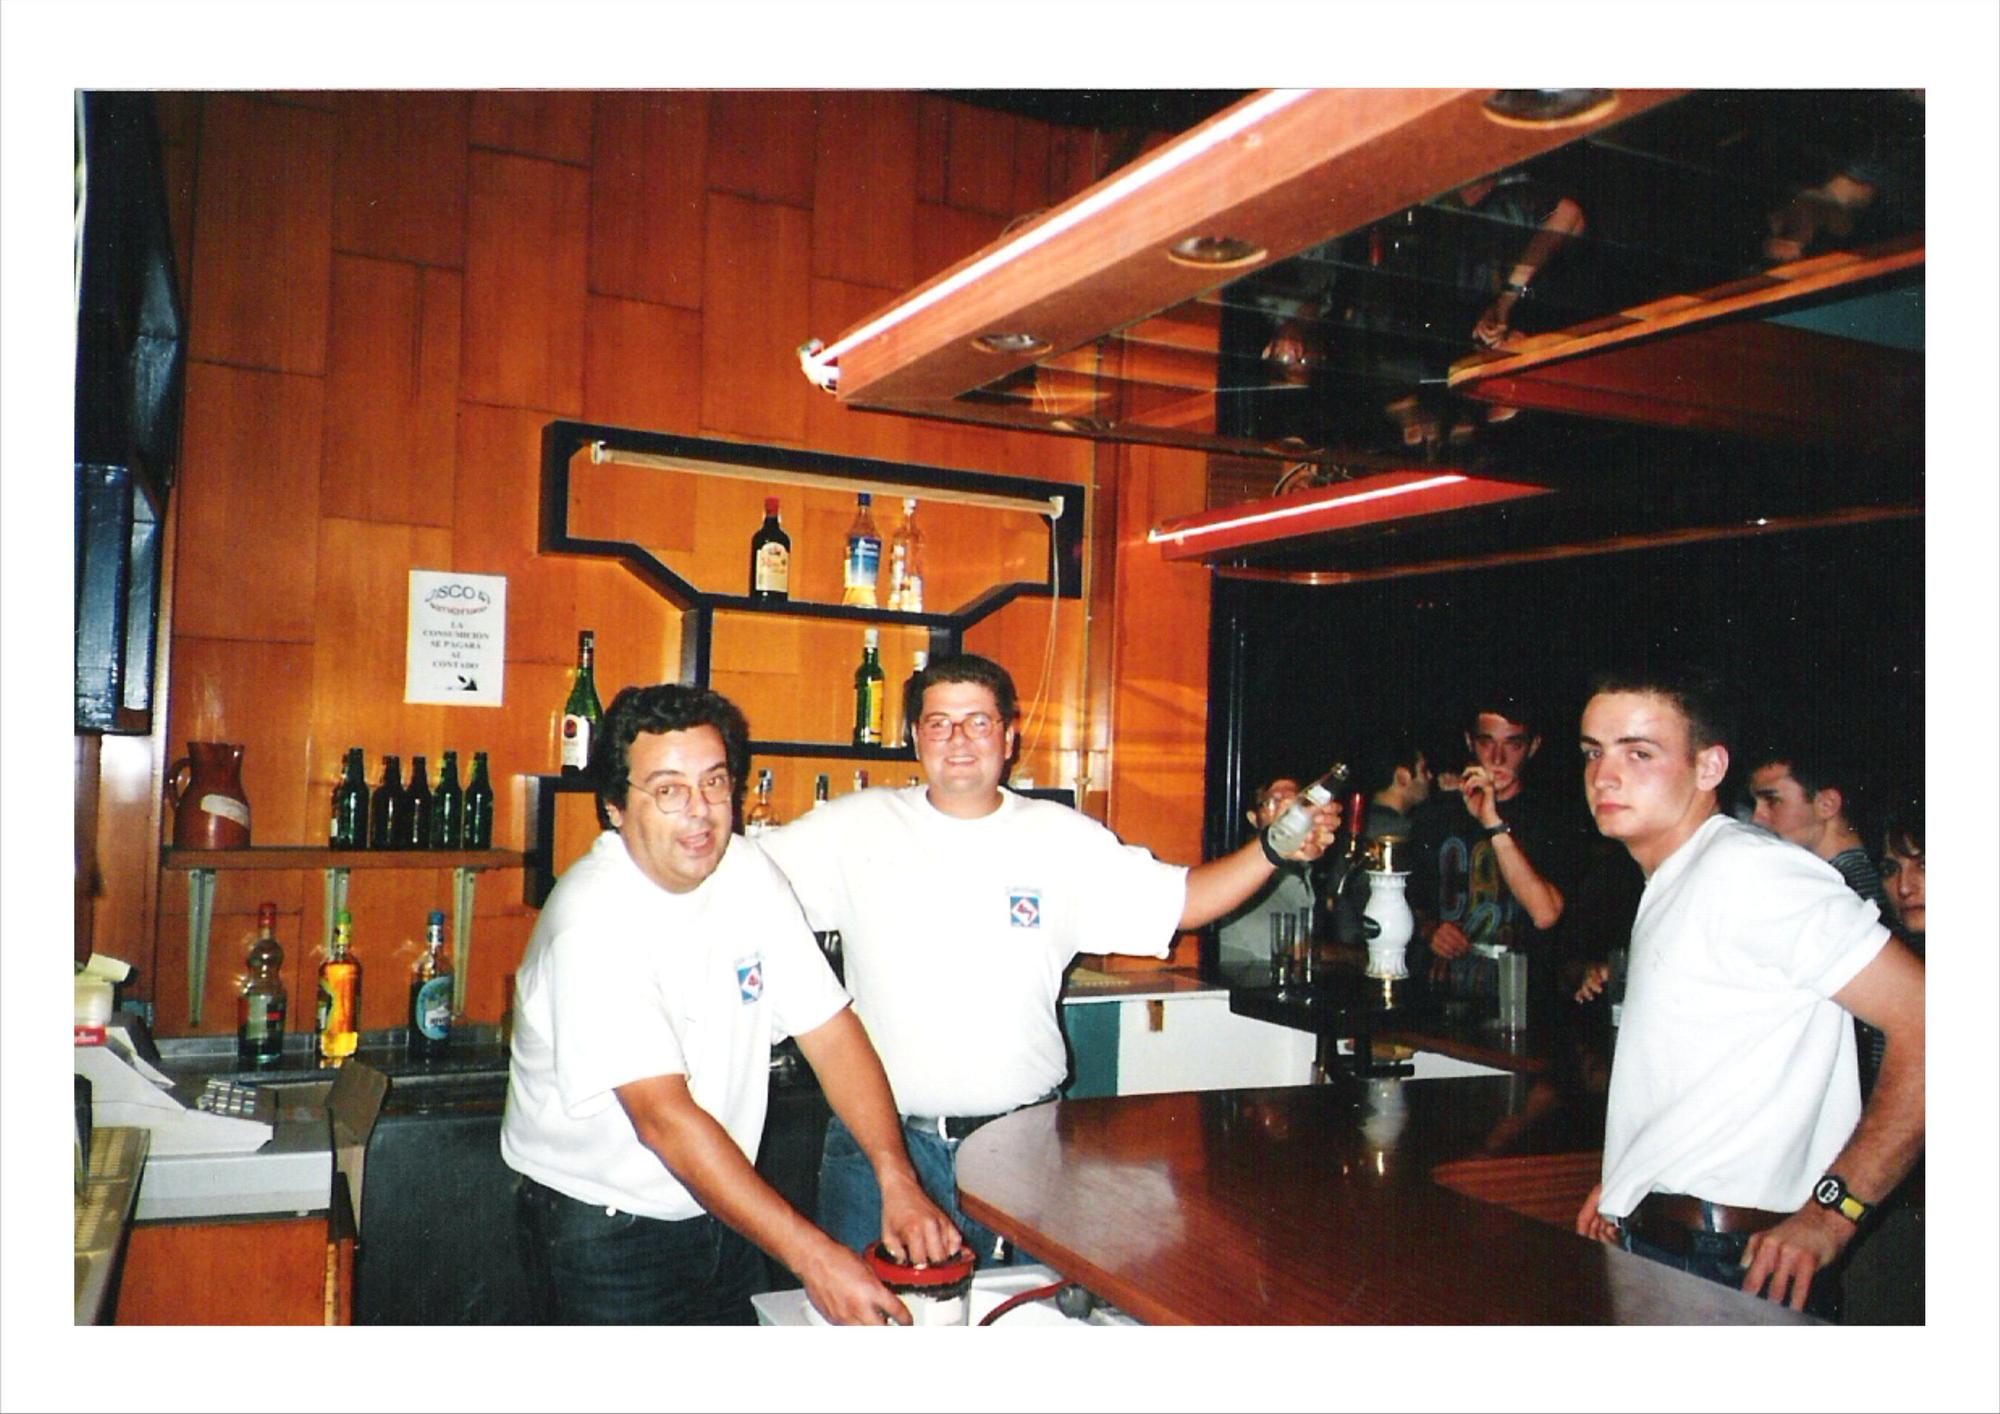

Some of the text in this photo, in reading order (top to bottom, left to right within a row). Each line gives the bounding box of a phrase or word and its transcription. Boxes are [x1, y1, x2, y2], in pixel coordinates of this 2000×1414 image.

[450, 621, 464, 629] LA
[430, 640, 441, 648] SE
[451, 651, 461, 659] AL
[432, 661, 479, 669] CONTADO
